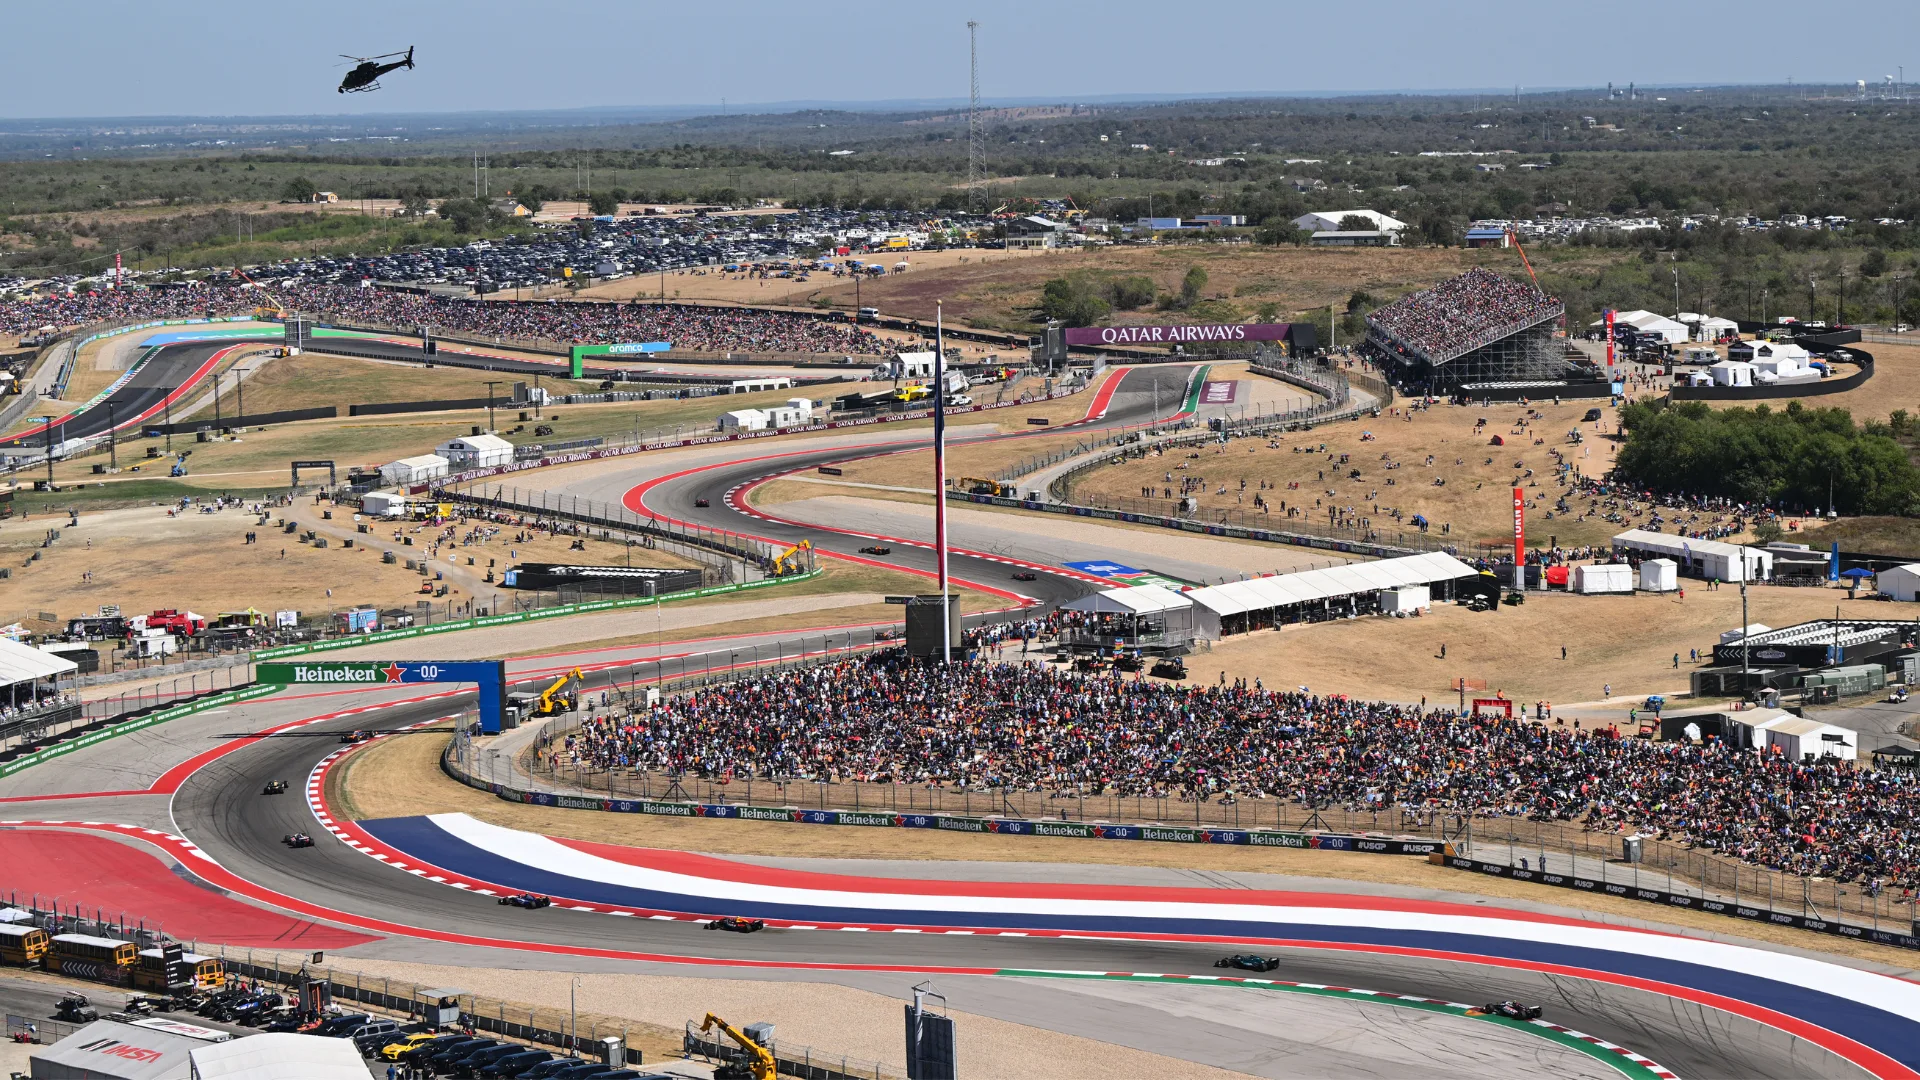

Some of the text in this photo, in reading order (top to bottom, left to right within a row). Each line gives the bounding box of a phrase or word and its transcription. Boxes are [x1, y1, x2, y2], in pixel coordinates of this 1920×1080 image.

[1102, 325, 1245, 344] QATAR AIRWAYS
[609, 344, 642, 353] aramco
[294, 666, 377, 682] Heineken
[557, 796, 598, 810] Heineken
[643, 803, 691, 815] Heineken
[740, 808, 789, 821] Heineken
[839, 813, 888, 826] Heineken
[938, 819, 982, 832] Heineken
[1035, 824, 1088, 837] Heineken
[1142, 829, 1195, 842] Heineken
[1249, 834, 1304, 847] Heineken
[1878, 932, 1892, 941] MSC
[1906, 937, 1920, 946] MSC
[101, 1044, 164, 1064] IMSA
